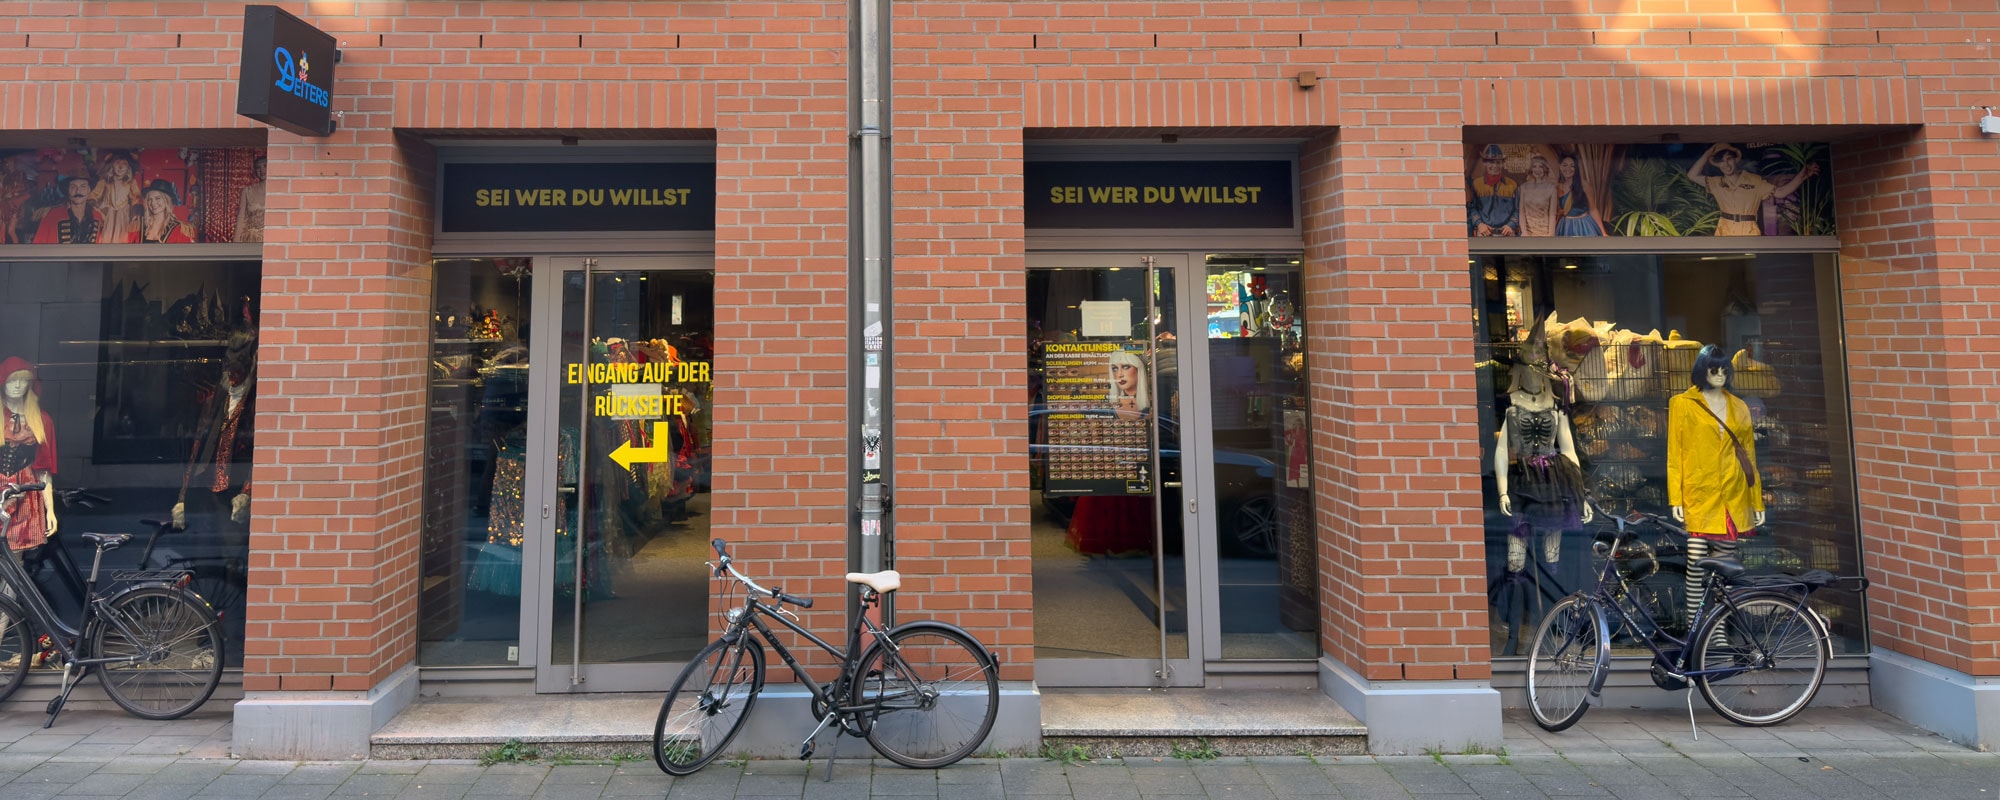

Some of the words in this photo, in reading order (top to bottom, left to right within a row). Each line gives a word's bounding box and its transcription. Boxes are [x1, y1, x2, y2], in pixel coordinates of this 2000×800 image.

[476, 189, 510, 206] SEI
[515, 189, 566, 206] WER
[572, 188, 604, 206] DU
[609, 188, 691, 206] WILLST
[1050, 186, 1083, 204] SEI
[1088, 186, 1139, 204] WER
[1143, 186, 1175, 204] DU
[1180, 186, 1261, 204] WILLST
[1045, 343, 1120, 352] KONTAKTLINSEN
[568, 362, 638, 384] EINGANG
[642, 362, 673, 382] AUF
[678, 361, 710, 382] DER
[595, 392, 683, 416] RÜCKSEITE
